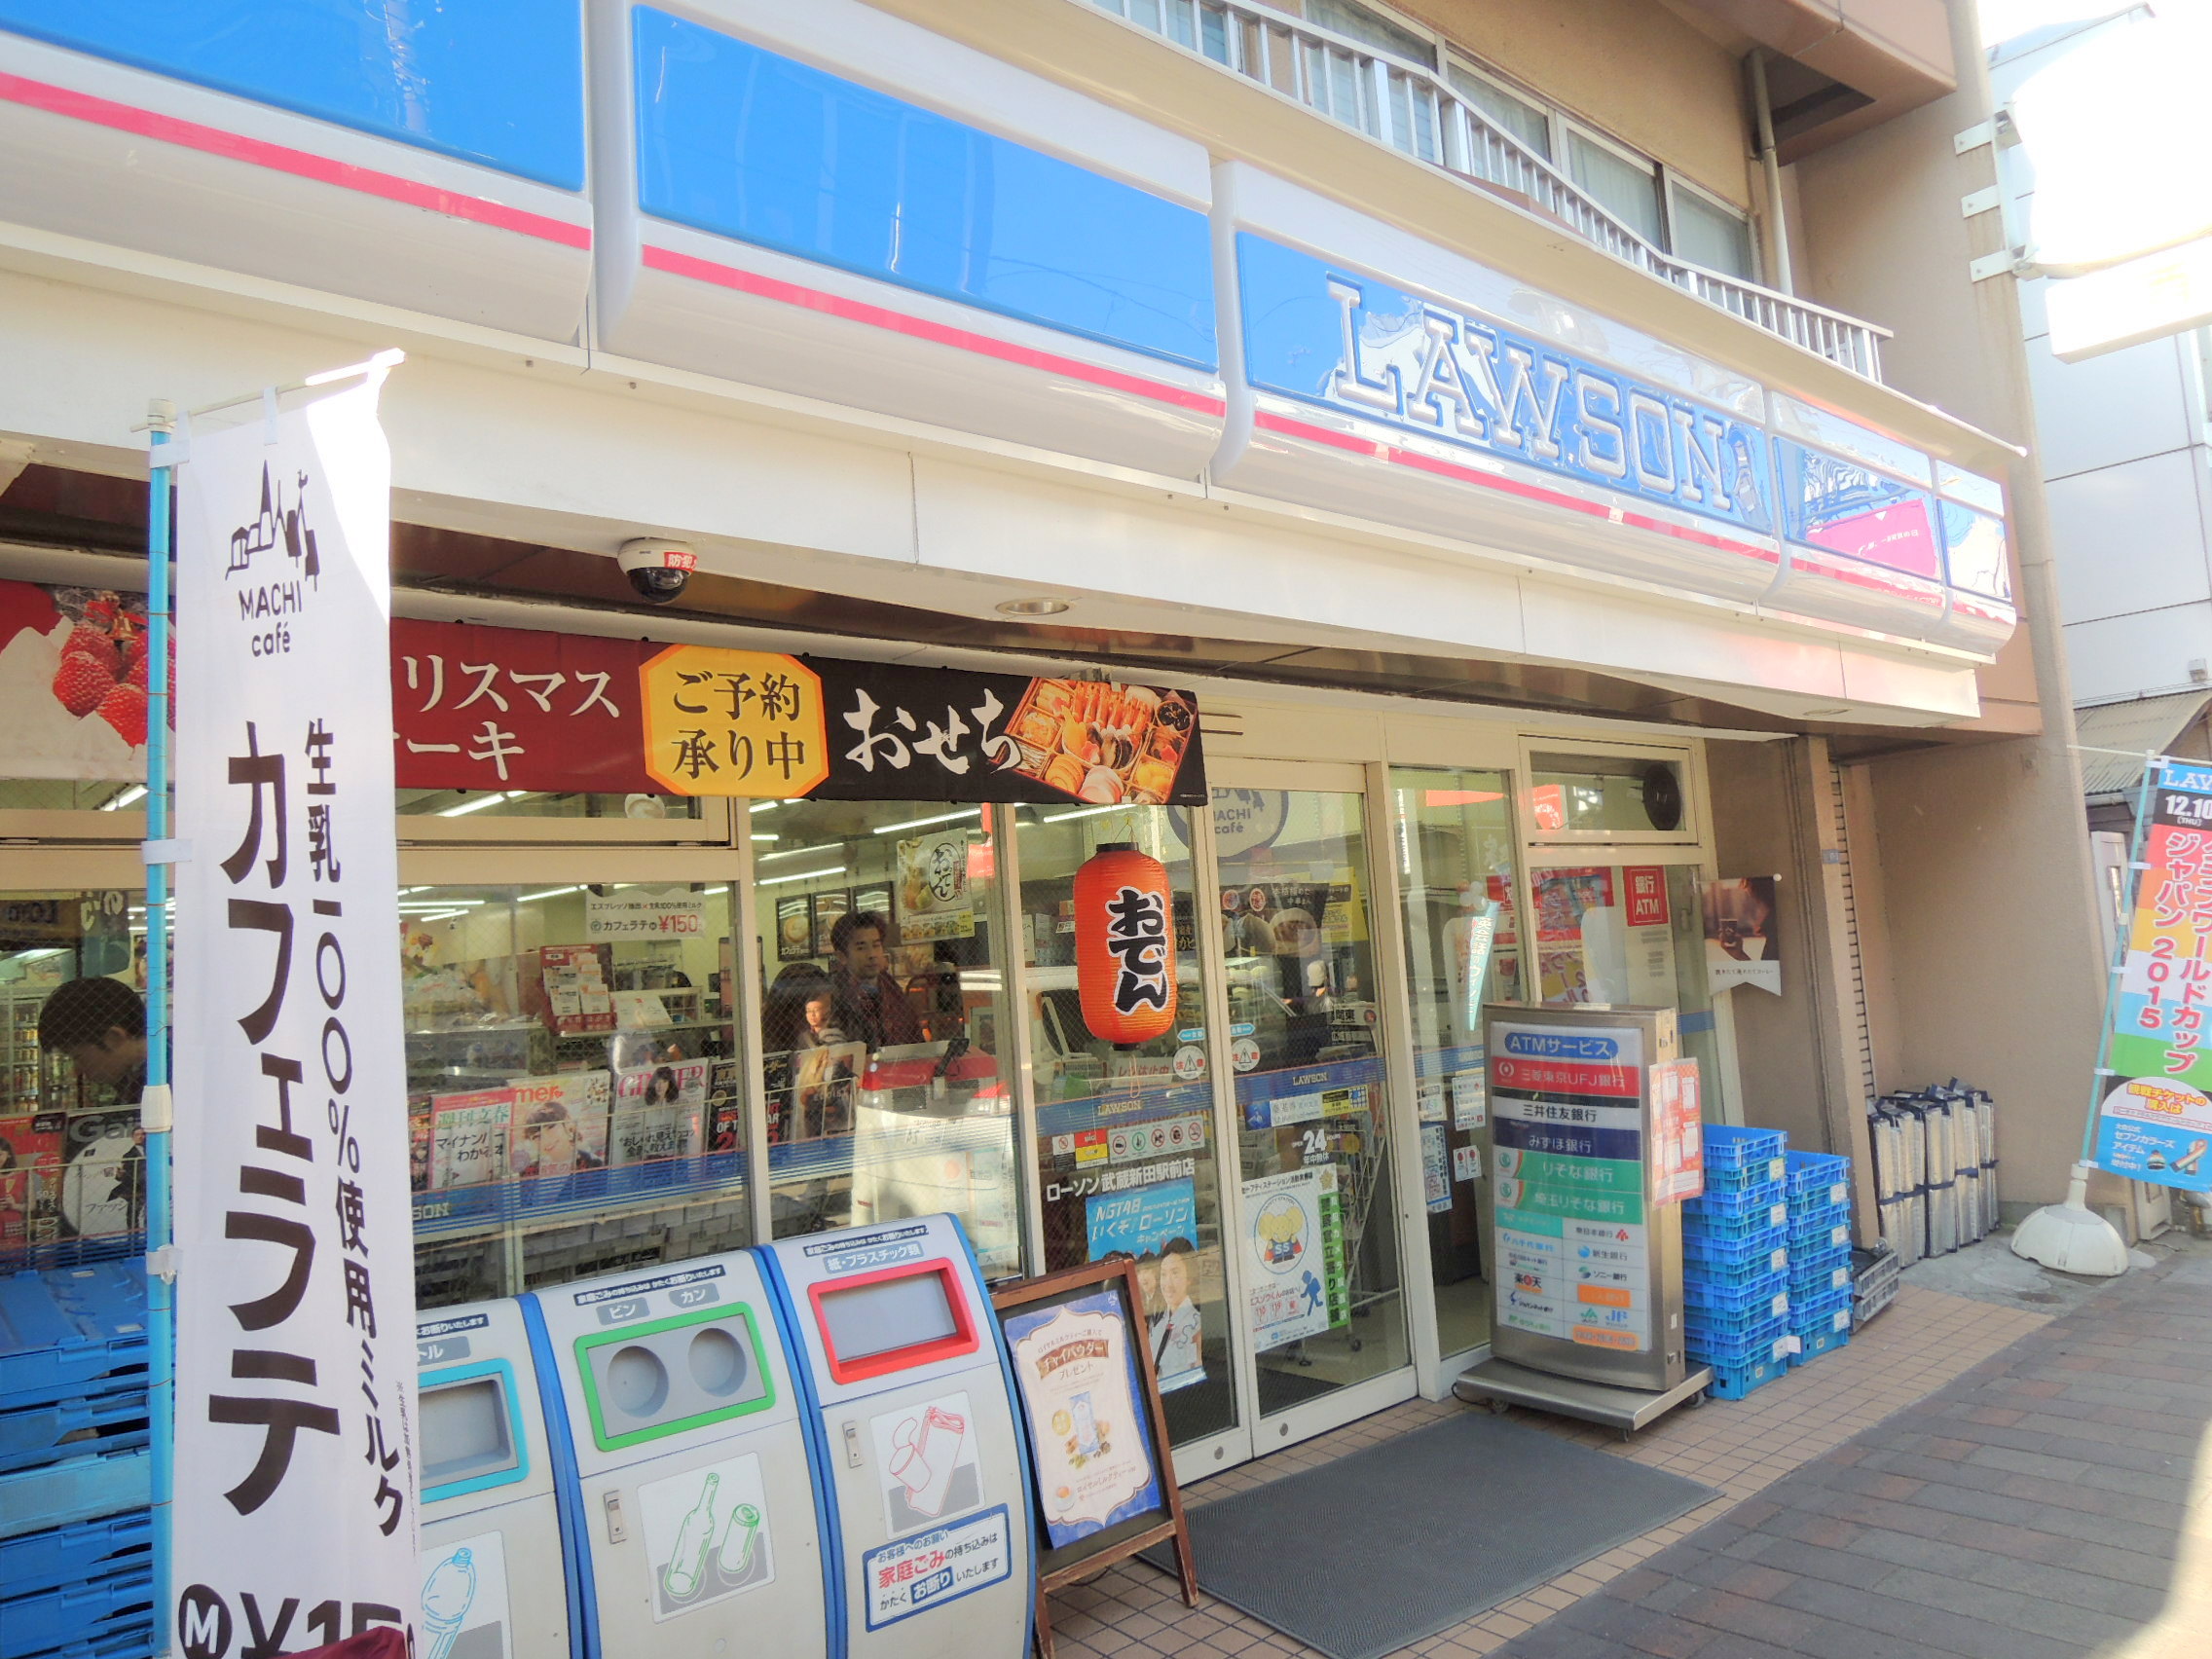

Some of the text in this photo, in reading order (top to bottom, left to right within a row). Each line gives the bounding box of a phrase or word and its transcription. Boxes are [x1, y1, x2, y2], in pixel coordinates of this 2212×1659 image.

[1325, 271, 1734, 511] LAWSON
[239, 581, 302, 621] MACHI
[252, 621, 291, 657] café
[392, 654, 620, 719] リスマス
[672, 669, 801, 719] ご予約
[841, 687, 1023, 776] おせち
[392, 719, 526, 781] ーキ
[672, 728, 807, 780] 承り中
[1215, 808, 1252, 822] ACHI
[1215, 822, 1244, 834] café
[1636, 875, 1654, 894] 銀行
[1636, 899, 1659, 915] ATM
[603, 919, 648, 932] カフェラテ
[658, 914, 698, 933] ¥150
[1105, 887, 1169, 1014] おでん
[1510, 1033, 1610, 1056] ATMサービス
[1292, 1072, 1328, 1087] LAWSON
[1521, 1068, 1625, 1088] 三菱東京UFJ銀行
[514, 1085, 559, 1104] mer
[208, 720, 340, 1516] カフェラテ
[1097, 1100, 1142, 1116] LAWSON
[1523, 1104, 1597, 1123] 三井住友銀行
[1303, 1129, 1327, 1155] 24
[1529, 1135, 1593, 1154] みずほ銀行
[1304, 1153, 1330, 1164] 年中無休
[1047, 1158, 1195, 1201] ローソン武蔵新田駅前店
[1543, 1161, 1613, 1183] りそな銀行
[1534, 1192, 1625, 1214] 埼玉りそな銀行
[1137, 1227, 1186, 1243] キャンペーン
[827, 1245, 921, 1272] 紙・プラスチック類
[1274, 1242, 1291, 1254] SS
[1593, 1270, 1628, 1281] ソニー銀行
[681, 1287, 706, 1305] カン
[608, 1302, 636, 1319] ビン
[1058, 1361, 1094, 1381] プレゼント
[877, 1530, 949, 1563] お客様へのお願い
[877, 1532, 999, 1590] 家庭ごみの持ち込みは
[879, 1558, 1000, 1612] かたく お断り いたします
